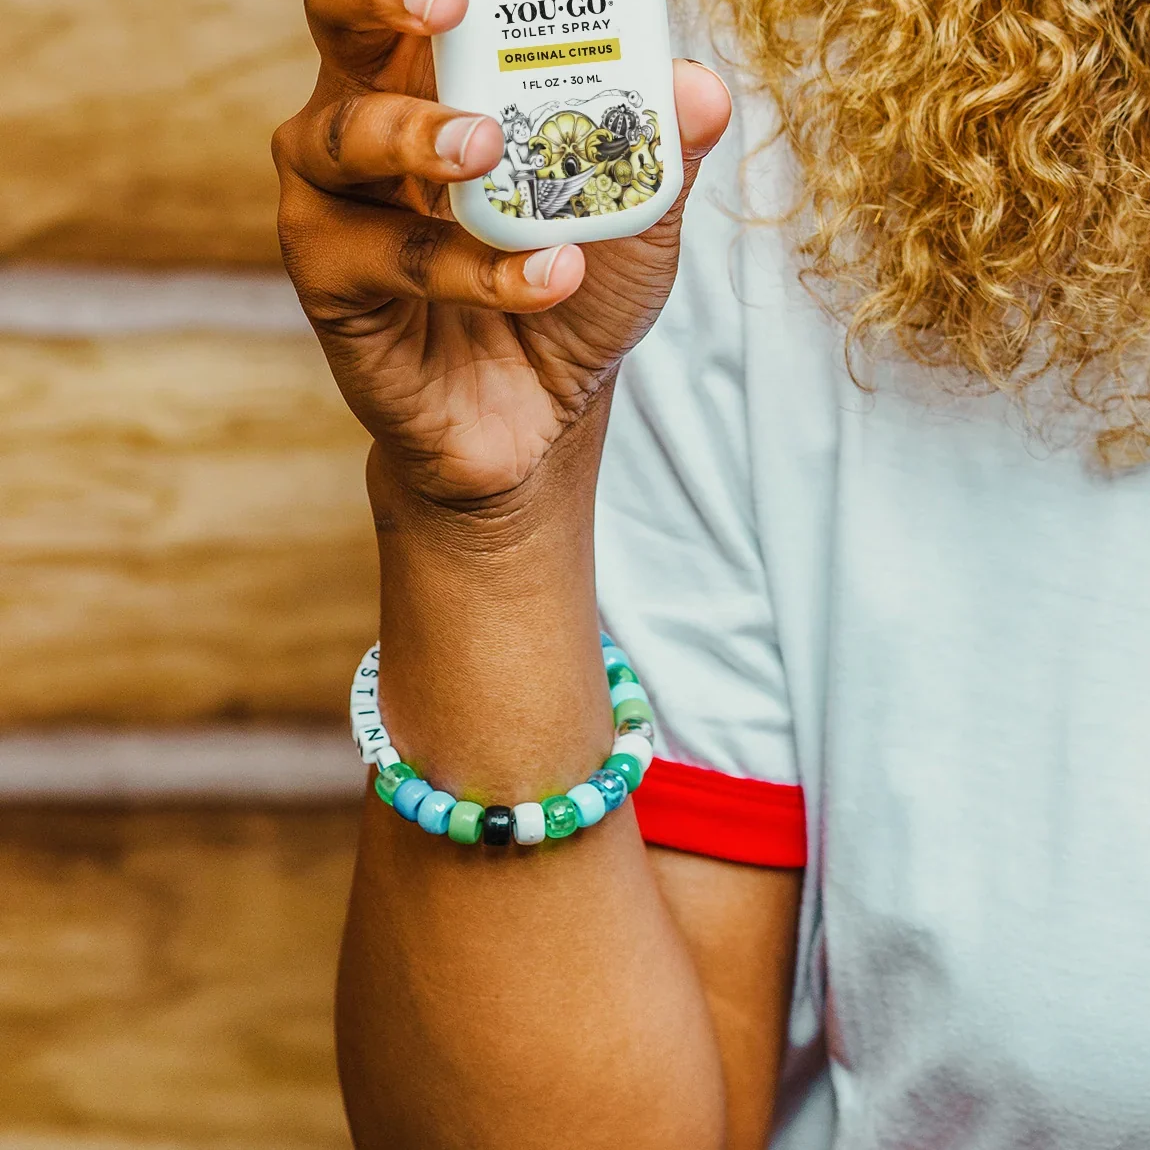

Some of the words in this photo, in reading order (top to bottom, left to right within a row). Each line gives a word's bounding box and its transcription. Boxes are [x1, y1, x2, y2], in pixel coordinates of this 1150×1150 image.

[501, 24, 555, 39] TOILET
[562, 19, 611, 33] SPRAY
[504, 49, 565, 63] ORIGINAL
[569, 44, 613, 58] CITRUS
[522, 81, 527, 90] 1
[530, 80, 542, 89] FL
[544, 78, 560, 88] OZ
[570, 76, 584, 86] 30
[586, 74, 603, 84] ML
